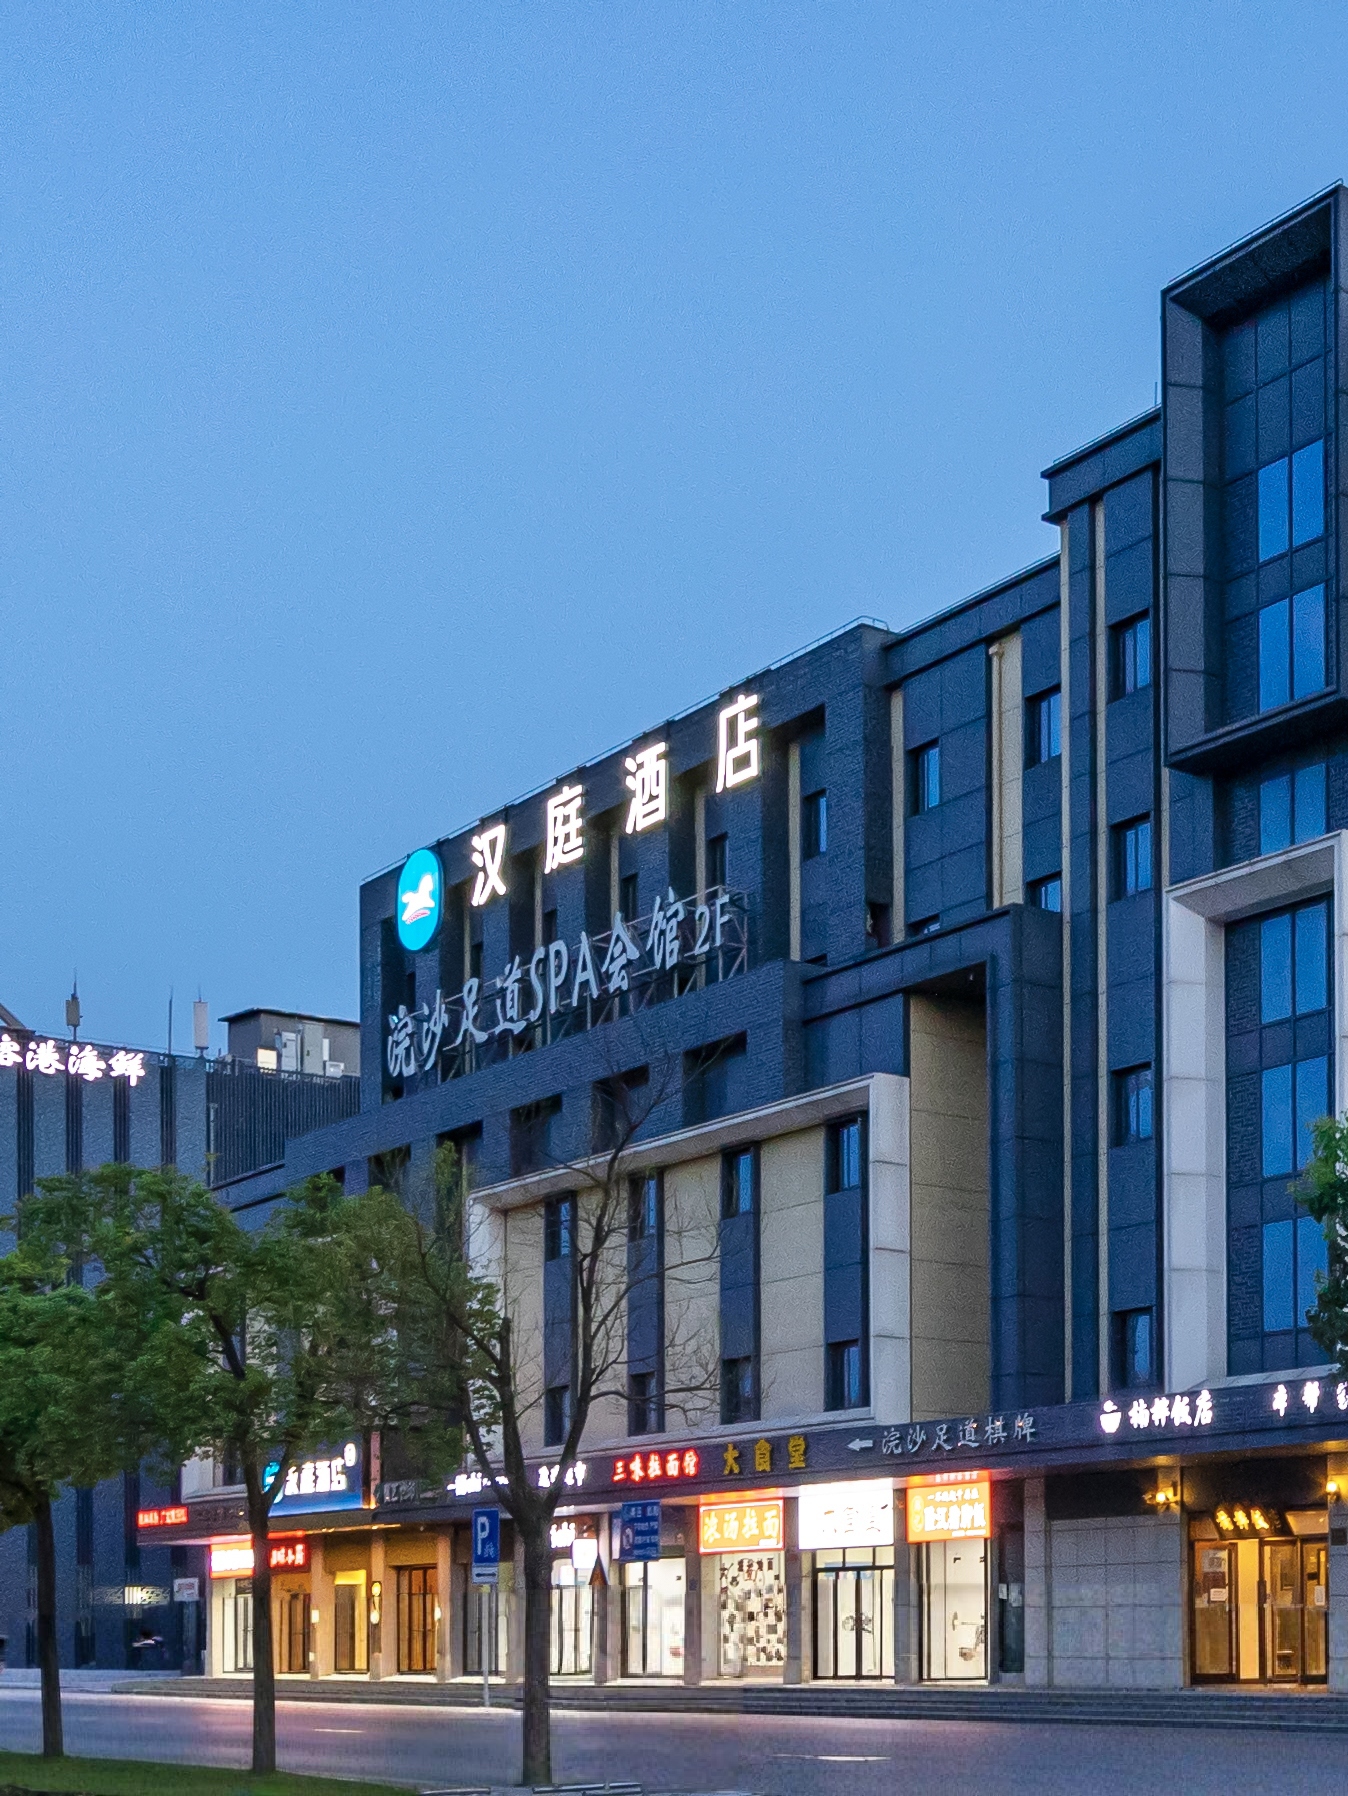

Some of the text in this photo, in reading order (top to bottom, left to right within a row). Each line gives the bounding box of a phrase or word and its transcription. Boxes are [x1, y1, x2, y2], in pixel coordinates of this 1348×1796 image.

[471, 694, 759, 907] 汉庭酒店
[476, 1515, 490, 1556] P
